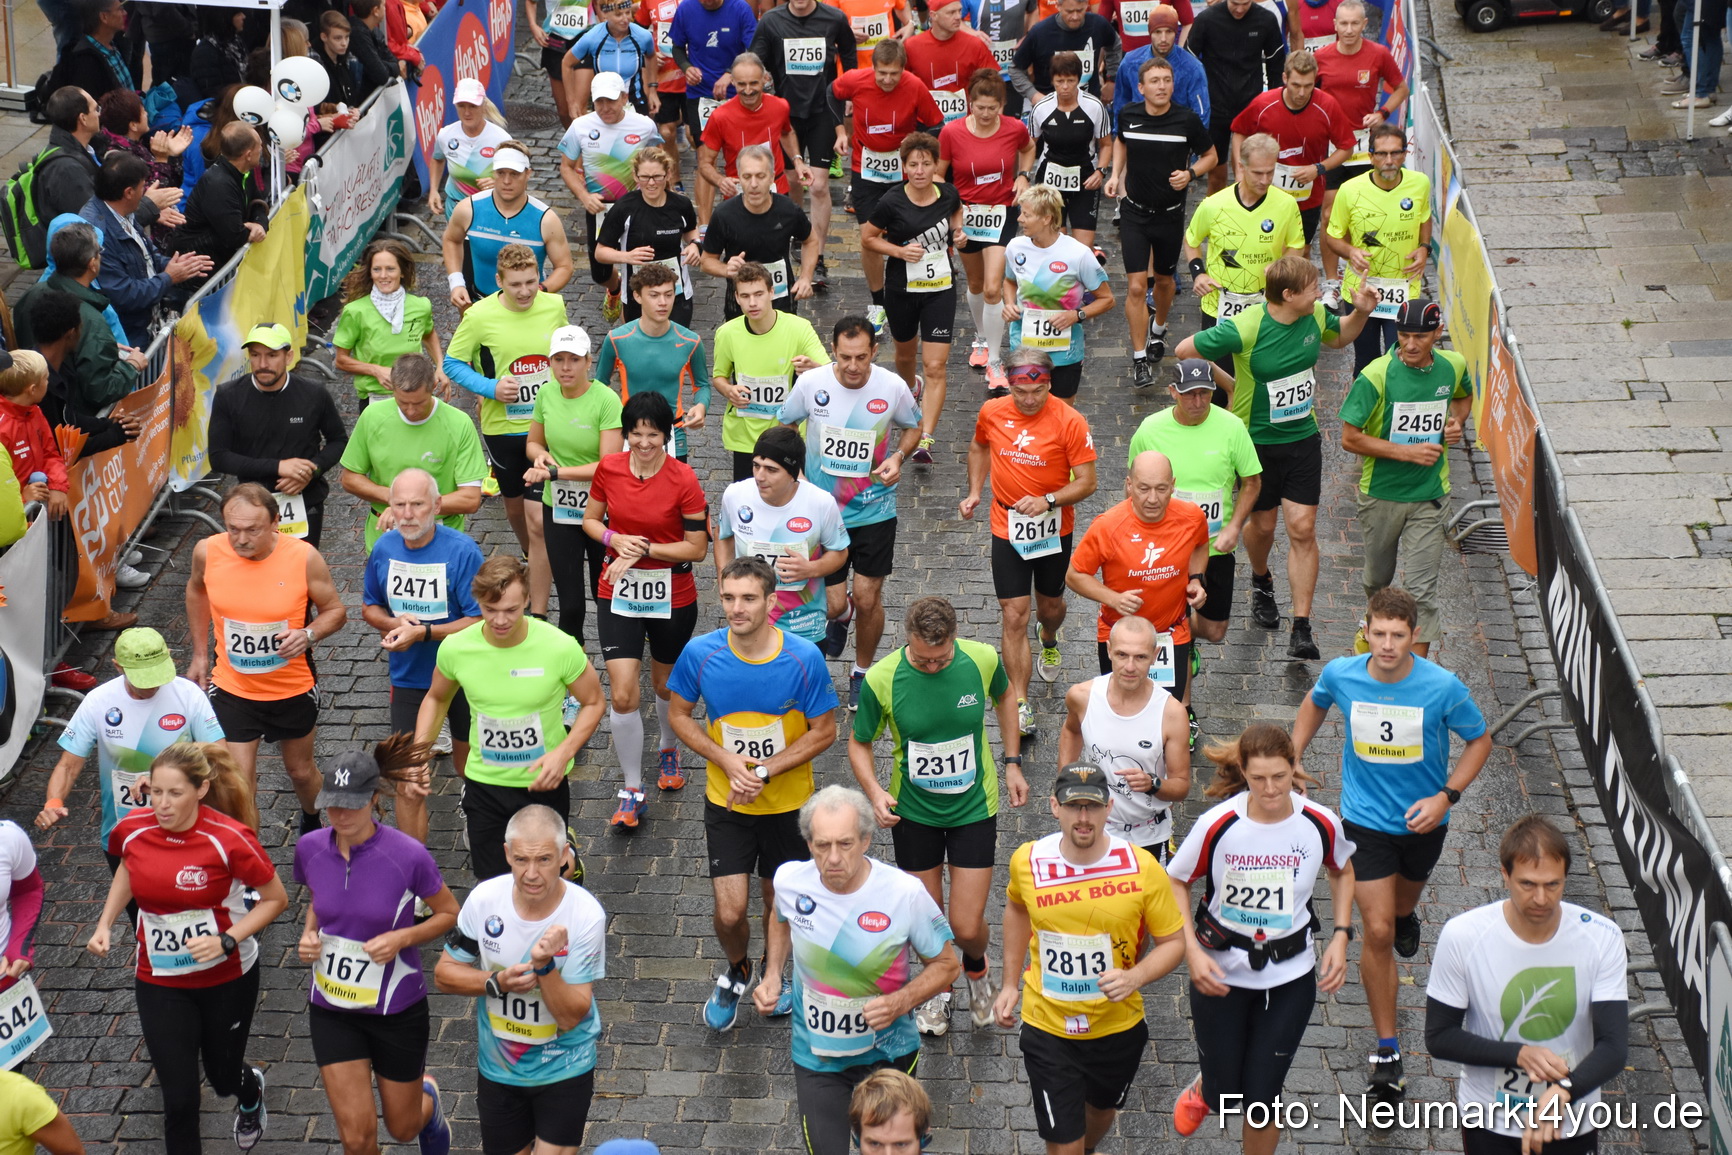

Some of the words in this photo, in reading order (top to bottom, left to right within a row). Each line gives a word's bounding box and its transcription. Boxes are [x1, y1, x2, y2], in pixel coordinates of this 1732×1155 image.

[554, 13, 584, 28] 3064
[455, 31, 489, 81] Hervis
[789, 47, 823, 62] 2756
[416, 84, 444, 153] Hervis
[865, 157, 899, 171] 2299
[1047, 172, 1079, 188] 3013
[966, 214, 1002, 228] 2060
[927, 264, 935, 279] 5
[1050, 263, 1067, 271] Hervis
[513, 360, 548, 373] Hervis
[1276, 381, 1312, 408] 2753
[1435, 386, 1451, 395] AOK
[869, 402, 887, 411] Hervis
[1283, 405, 1309, 417] Gerhard
[1398, 413, 1442, 433] 2456
[1408, 436, 1431, 445] Albert
[824, 438, 870, 460] 2805
[1000, 448, 1040, 461] funrunners
[830, 461, 858, 471] Homaid
[1011, 456, 1047, 467] neumarkt
[862, 490, 875, 500] 17.
[788, 519, 810, 530] Hervis
[1015, 518, 1057, 541] 2614
[1023, 540, 1049, 553] Hartmut
[1128, 565, 1175, 577] funrunners
[1142, 568, 1180, 582] neumarkt
[393, 575, 438, 599] 2471
[618, 578, 666, 600] 2109
[402, 602, 430, 613] Norbert
[628, 602, 654, 612] Sabine
[240, 657, 275, 668] Michael
[957, 693, 978, 706] AOK
[162, 718, 183, 728] Hervis
[483, 727, 538, 749] 2353
[1380, 721, 1394, 742] 3
[734, 738, 774, 760] 286
[1368, 746, 1405, 757] Michael
[495, 752, 531, 762] Valentin
[916, 749, 971, 776] 2317
[928, 777, 963, 788] Thomas
[1225, 854, 1301, 867] SPARKASSEN
[1036, 889, 1081, 909] MAX
[1089, 880, 1143, 900] BÖGL
[1225, 884, 1284, 911] 2221
[794, 916, 814, 928] PARTL
[862, 916, 888, 928] Hervis
[1240, 912, 1268, 926] Sonja
[326, 953, 370, 983] 167
[1046, 948, 1106, 976] 2813
[324, 981, 357, 1001] Kathrin
[1061, 981, 1091, 993] Ralph
[501, 993, 540, 1023] 101
[808, 1004, 869, 1035] 3049
[505, 1021, 532, 1037] Claus
[11, 1034, 32, 1056] Julia
